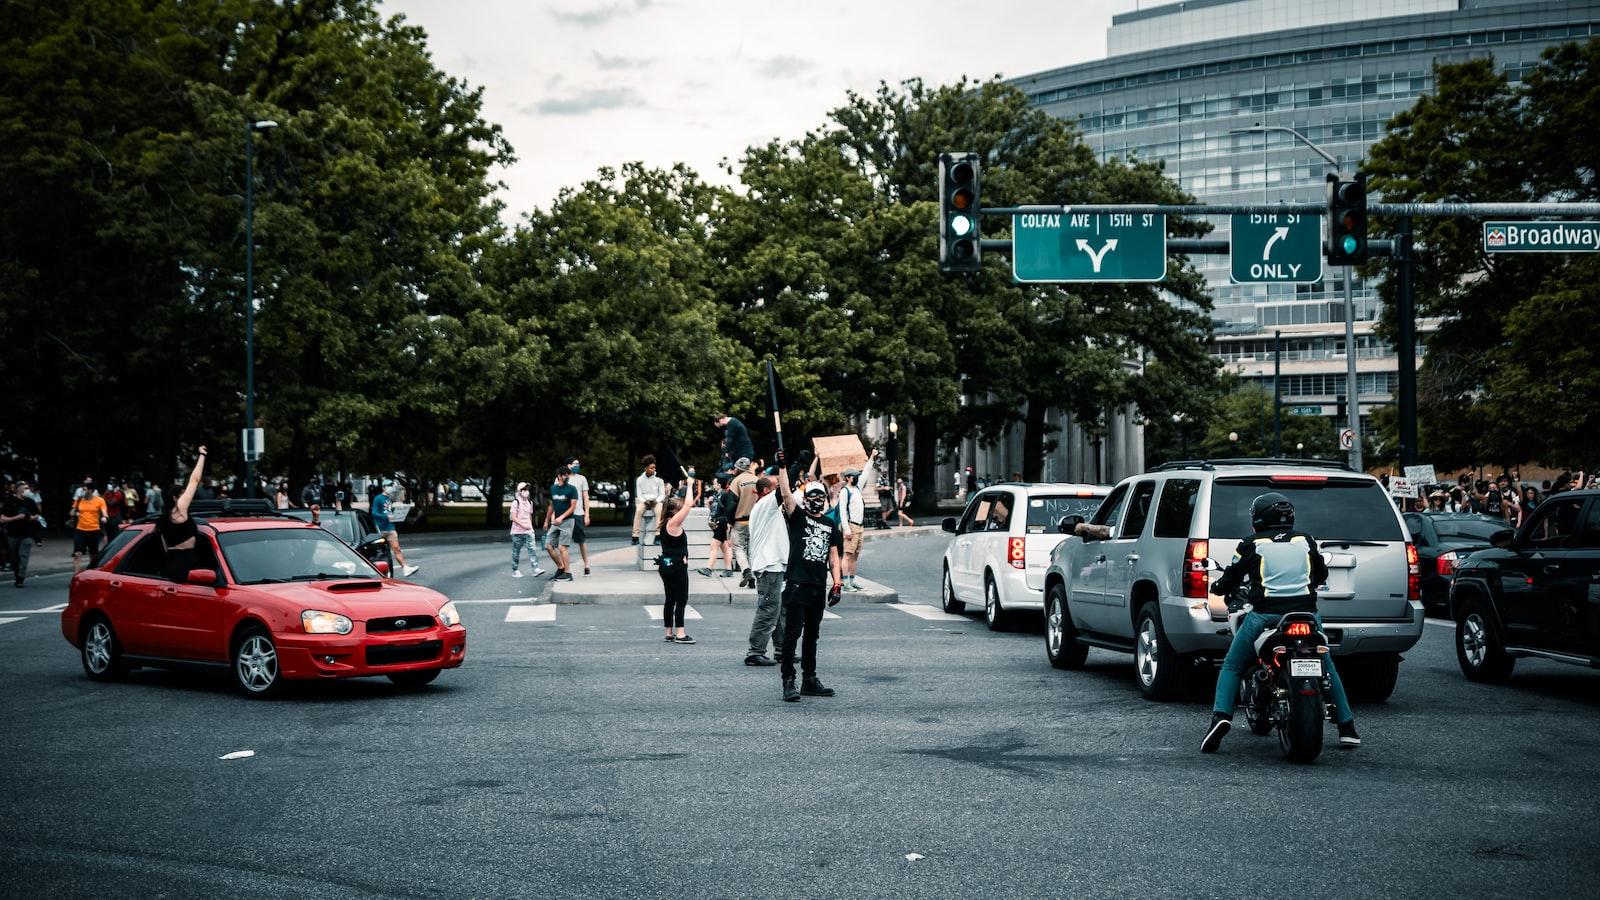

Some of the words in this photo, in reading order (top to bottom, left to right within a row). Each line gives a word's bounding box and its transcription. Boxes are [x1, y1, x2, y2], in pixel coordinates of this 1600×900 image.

[1021, 214, 1060, 227] COLFAX
[1070, 214, 1090, 227] AVE
[1109, 214, 1132, 227] 15TH
[1142, 214, 1154, 227] ST
[1250, 213, 1277, 224] 15TH
[1507, 225, 1600, 249] Broadway
[1250, 264, 1302, 279] ONLY
